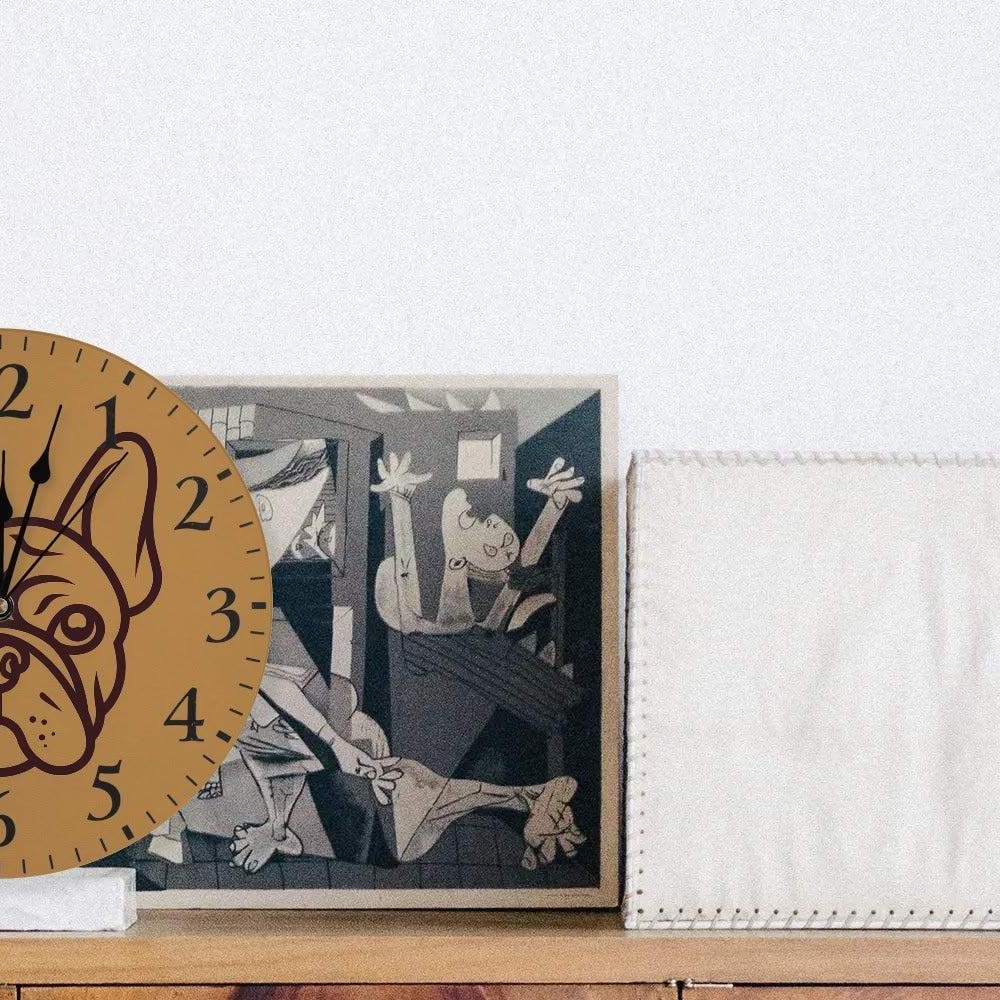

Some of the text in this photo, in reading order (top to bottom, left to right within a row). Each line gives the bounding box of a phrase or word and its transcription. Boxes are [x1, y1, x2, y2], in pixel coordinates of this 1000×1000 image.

[95, 394, 123, 450] 1
[174, 475, 215, 531] 2
[206, 587, 240, 644] 3
[163, 687, 205, 742] 4
[88, 759, 122, 821] 5
